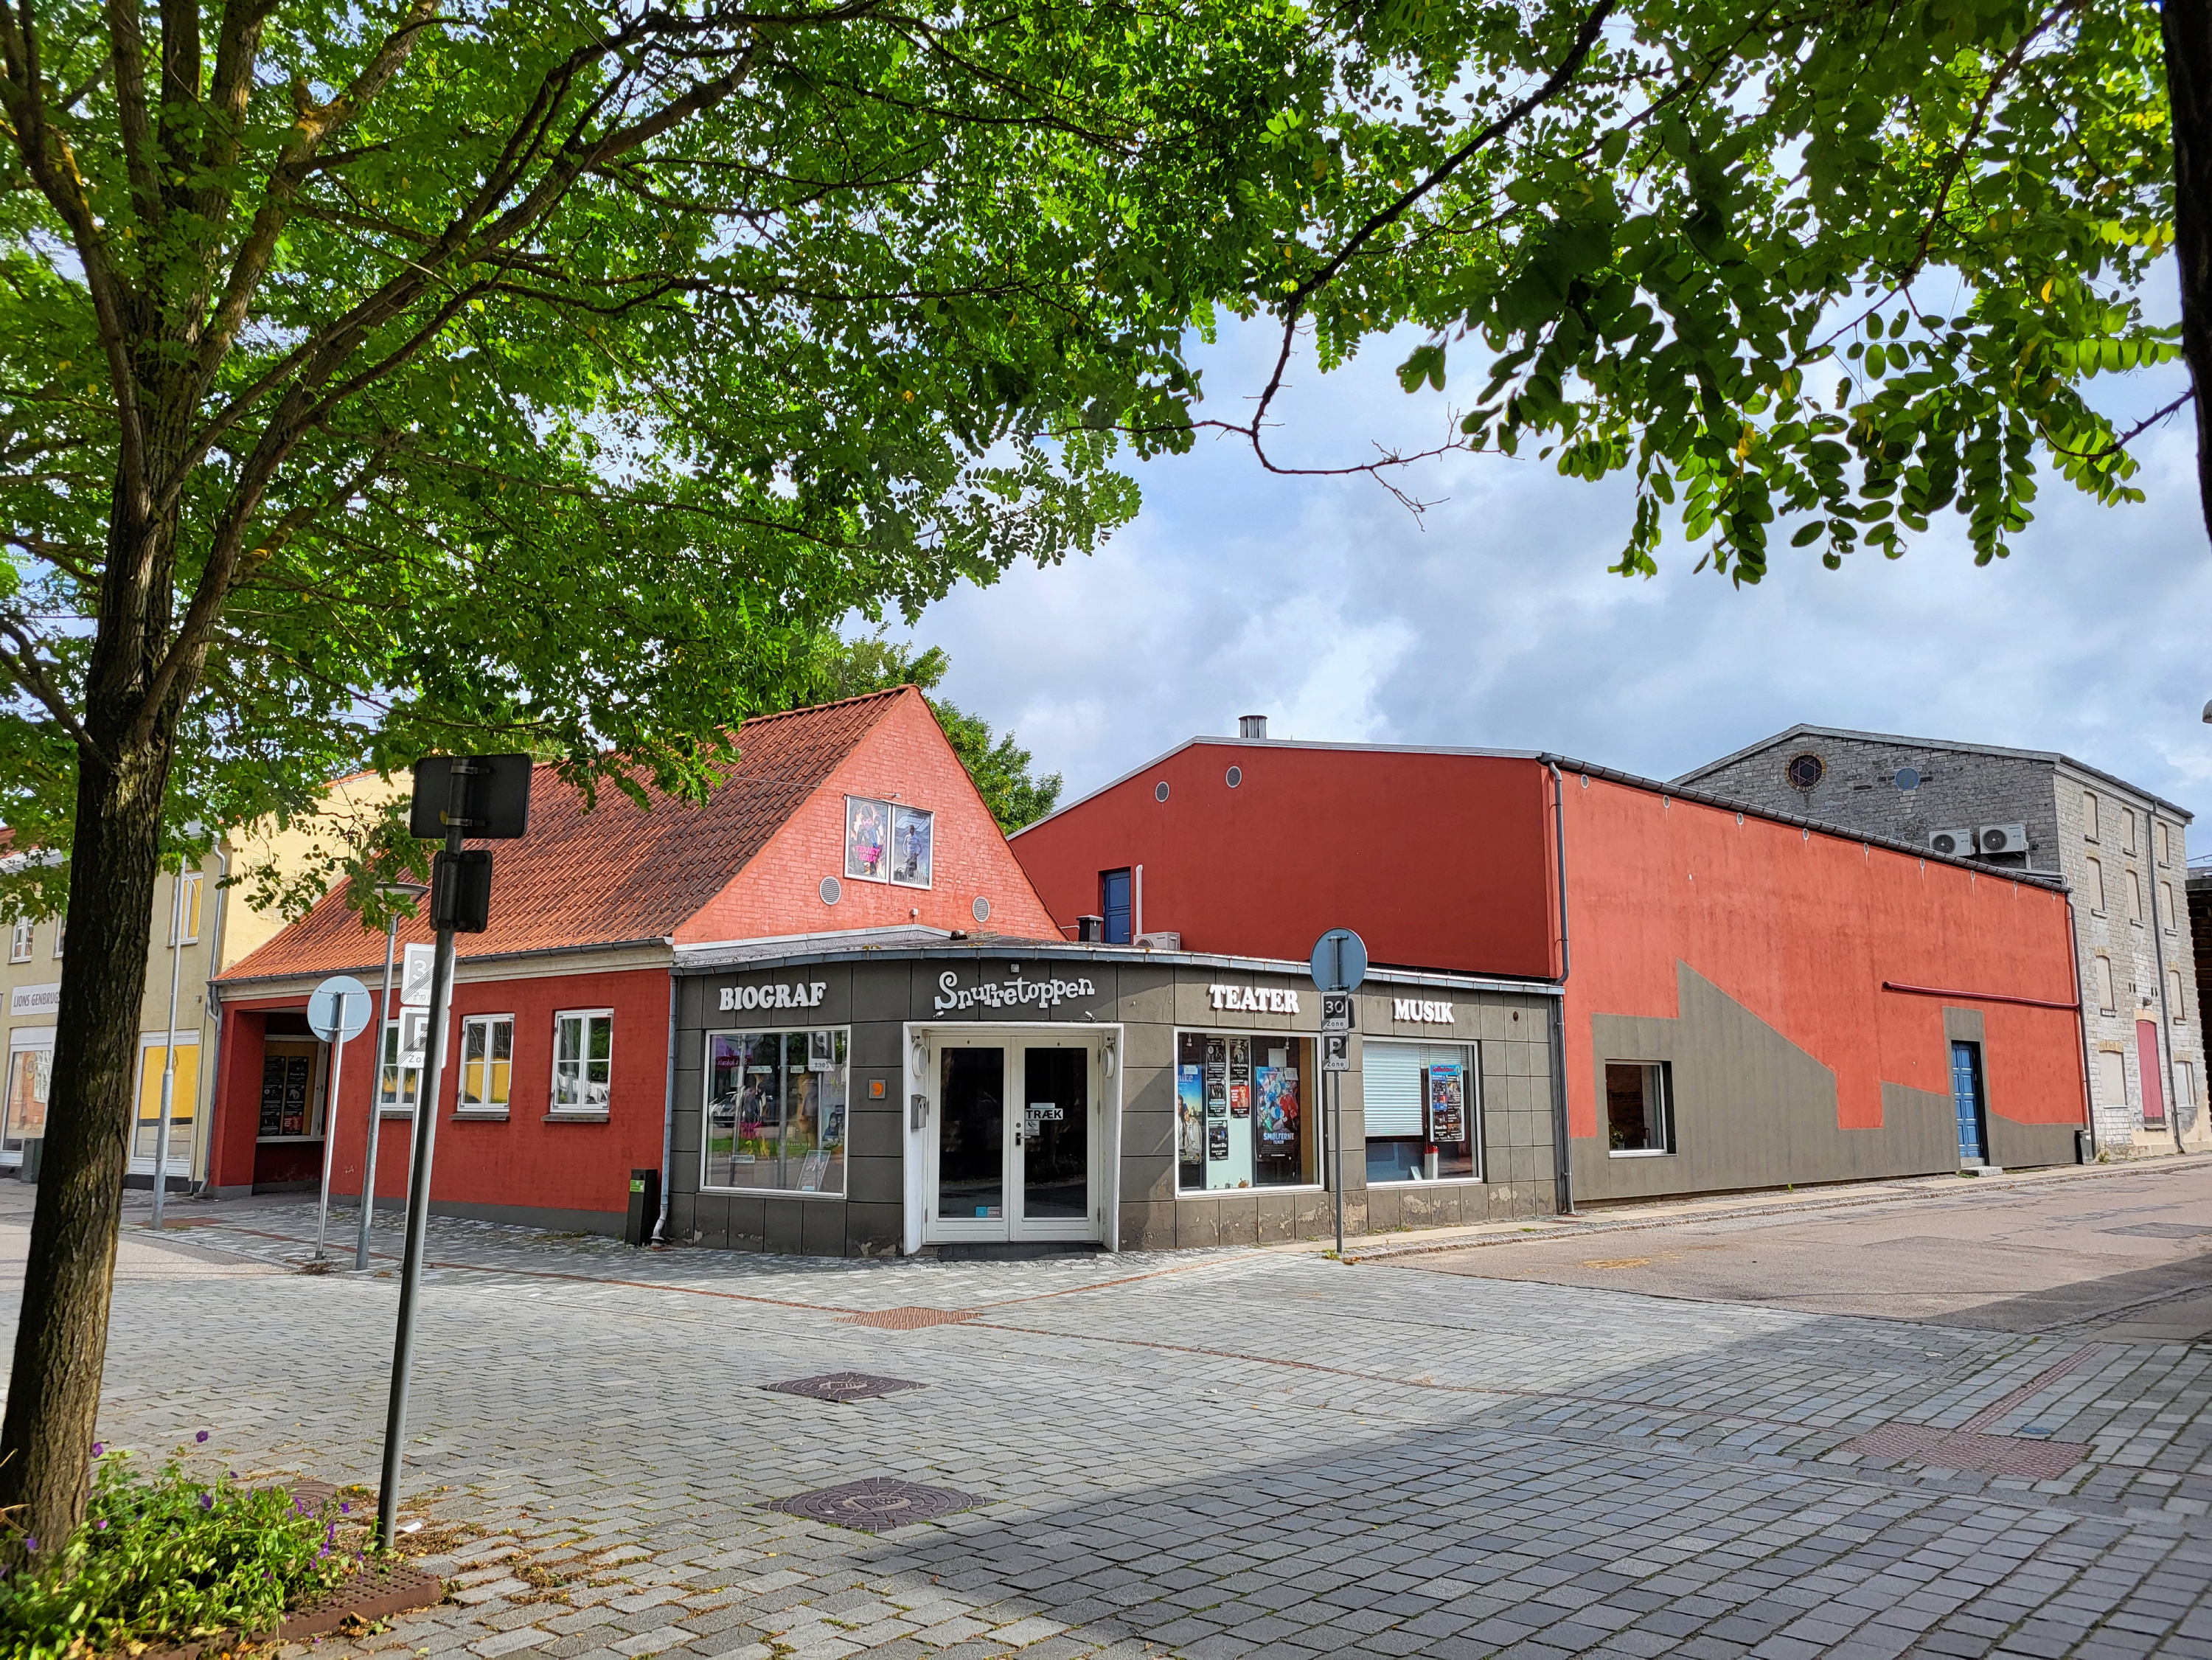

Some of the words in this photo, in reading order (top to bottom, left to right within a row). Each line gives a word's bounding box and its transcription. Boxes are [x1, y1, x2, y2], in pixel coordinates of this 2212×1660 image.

[855, 844, 880, 855] TERNET
[858, 852, 877, 863] NINJA
[863, 861, 871, 875] 3
[412, 959, 435, 982] 3
[719, 982, 827, 1011] BIOGRAF
[934, 970, 1095, 1010] Snurretoppen
[13, 994, 31, 1008] LIONS
[31, 991, 60, 1006] GENBRUG
[1209, 984, 1301, 1014] TEATER
[1325, 1000, 1344, 1013] 30
[1394, 998, 1455, 1024] MUSIK
[1329, 1038, 1342, 1056] P
[1026, 1109, 1062, 1119] TRÆK
[1263, 1132, 1295, 1141] SMØLFERNE
